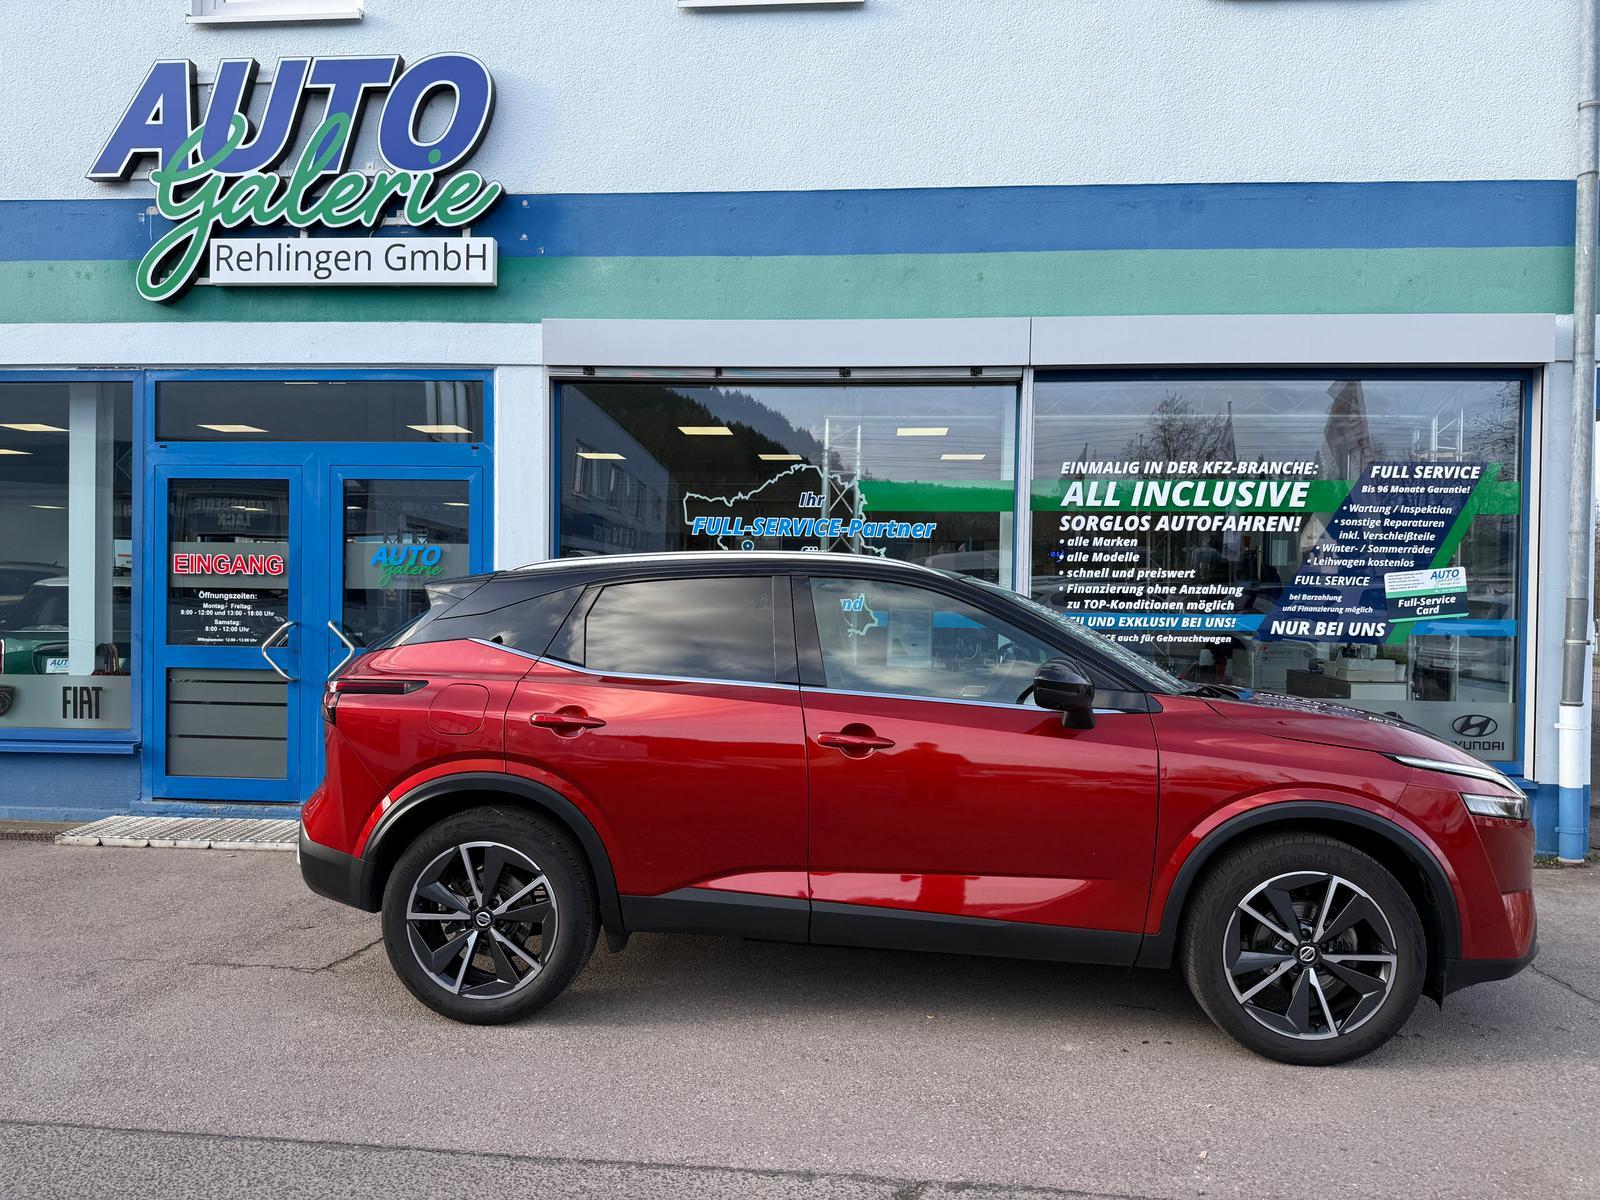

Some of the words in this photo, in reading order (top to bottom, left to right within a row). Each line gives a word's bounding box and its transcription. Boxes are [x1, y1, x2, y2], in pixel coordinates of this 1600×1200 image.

[85, 52, 494, 178] AUTO
[136, 111, 503, 302] Galerie
[215, 243, 372, 279] Rehlingen
[384, 242, 488, 271] GmbH
[1061, 461, 1140, 474] EINMALIG
[1144, 461, 1164, 474] IN
[1168, 461, 1198, 474] DER
[1202, 461, 1319, 475] KFZ-BRANCHE:
[1370, 465, 1410, 479] FULL
[1414, 466, 1481, 479] SERVICE
[1060, 481, 1121, 507] ALL
[1130, 481, 1310, 508] INCLUSIVE
[1361, 485, 1375, 494] Bis
[1377, 485, 1389, 494] 96
[1390, 485, 1426, 494] Monate
[1427, 485, 1471, 494] Garantie!
[799, 492, 826, 508] Ihr
[1350, 504, 1391, 516] Wartung
[1393, 504, 1399, 514] /
[1400, 505, 1452, 516] Inspektion
[692, 517, 938, 539] FULL-SERVICE-Partner
[1059, 515, 1151, 532] SORGLOS
[1155, 515, 1302, 532] AUTOFAHREN!
[1340, 518, 1380, 530] sonstige
[1383, 518, 1445, 529] Reparaturen
[1067, 536, 1090, 547] alle
[1092, 536, 1138, 547] Marken
[1339, 531, 1360, 540] inkl.
[1363, 531, 1436, 542] Verschleißteile
[1322, 544, 1359, 554] Winter-
[1367, 544, 1435, 554] Sommerräder
[369, 545, 444, 567] AUTO
[1067, 552, 1089, 562] alle
[1092, 552, 1140, 562] Modelle
[173, 553, 284, 576] EINGANG
[1314, 557, 1366, 569] Leihwagen
[1368, 557, 1415, 568] kostenlos
[1066, 568, 1109, 579] schnell
[1111, 568, 1134, 578] und
[1136, 569, 1196, 582] preiswert
[1430, 569, 1460, 580] AUTO
[1294, 576, 1321, 586] FULL
[1324, 576, 1370, 586] SERVICE
[198, 591, 258, 600] Öffnungszeiten:
[1067, 584, 1144, 597] Finanzierung
[1147, 584, 1177, 595] ohne
[1179, 584, 1244, 597] Anzahlung
[1289, 593, 1301, 601] bei
[1302, 593, 1343, 602] Barzahlung
[1398, 595, 1456, 608] Full-Service
[1066, 601, 1081, 610] zu
[1084, 599, 1183, 611] TOP-Konditionen
[1186, 600, 1235, 613] möglich
[1282, 605, 1296, 613] und
[1297, 605, 1343, 614] Finanzierung
[1345, 606, 1373, 615] möglich
[1416, 605, 1440, 615] Card
[1088, 616, 1116, 627] UND
[1118, 616, 1179, 627] EXKLUSIV
[1181, 617, 1201, 627] BEI
[1204, 617, 1236, 628] UNS!
[1271, 621, 1311, 635] NUR
[1314, 621, 1346, 636] BEI
[1349, 622, 1386, 637] UNS
[1117, 634, 1139, 642] auch
[1140, 634, 1155, 644] für
[1156, 635, 1232, 645] Gebrauchtwagen
[62, 686, 103, 719] FIAT
[1451, 740, 1505, 751] YUNDAI
